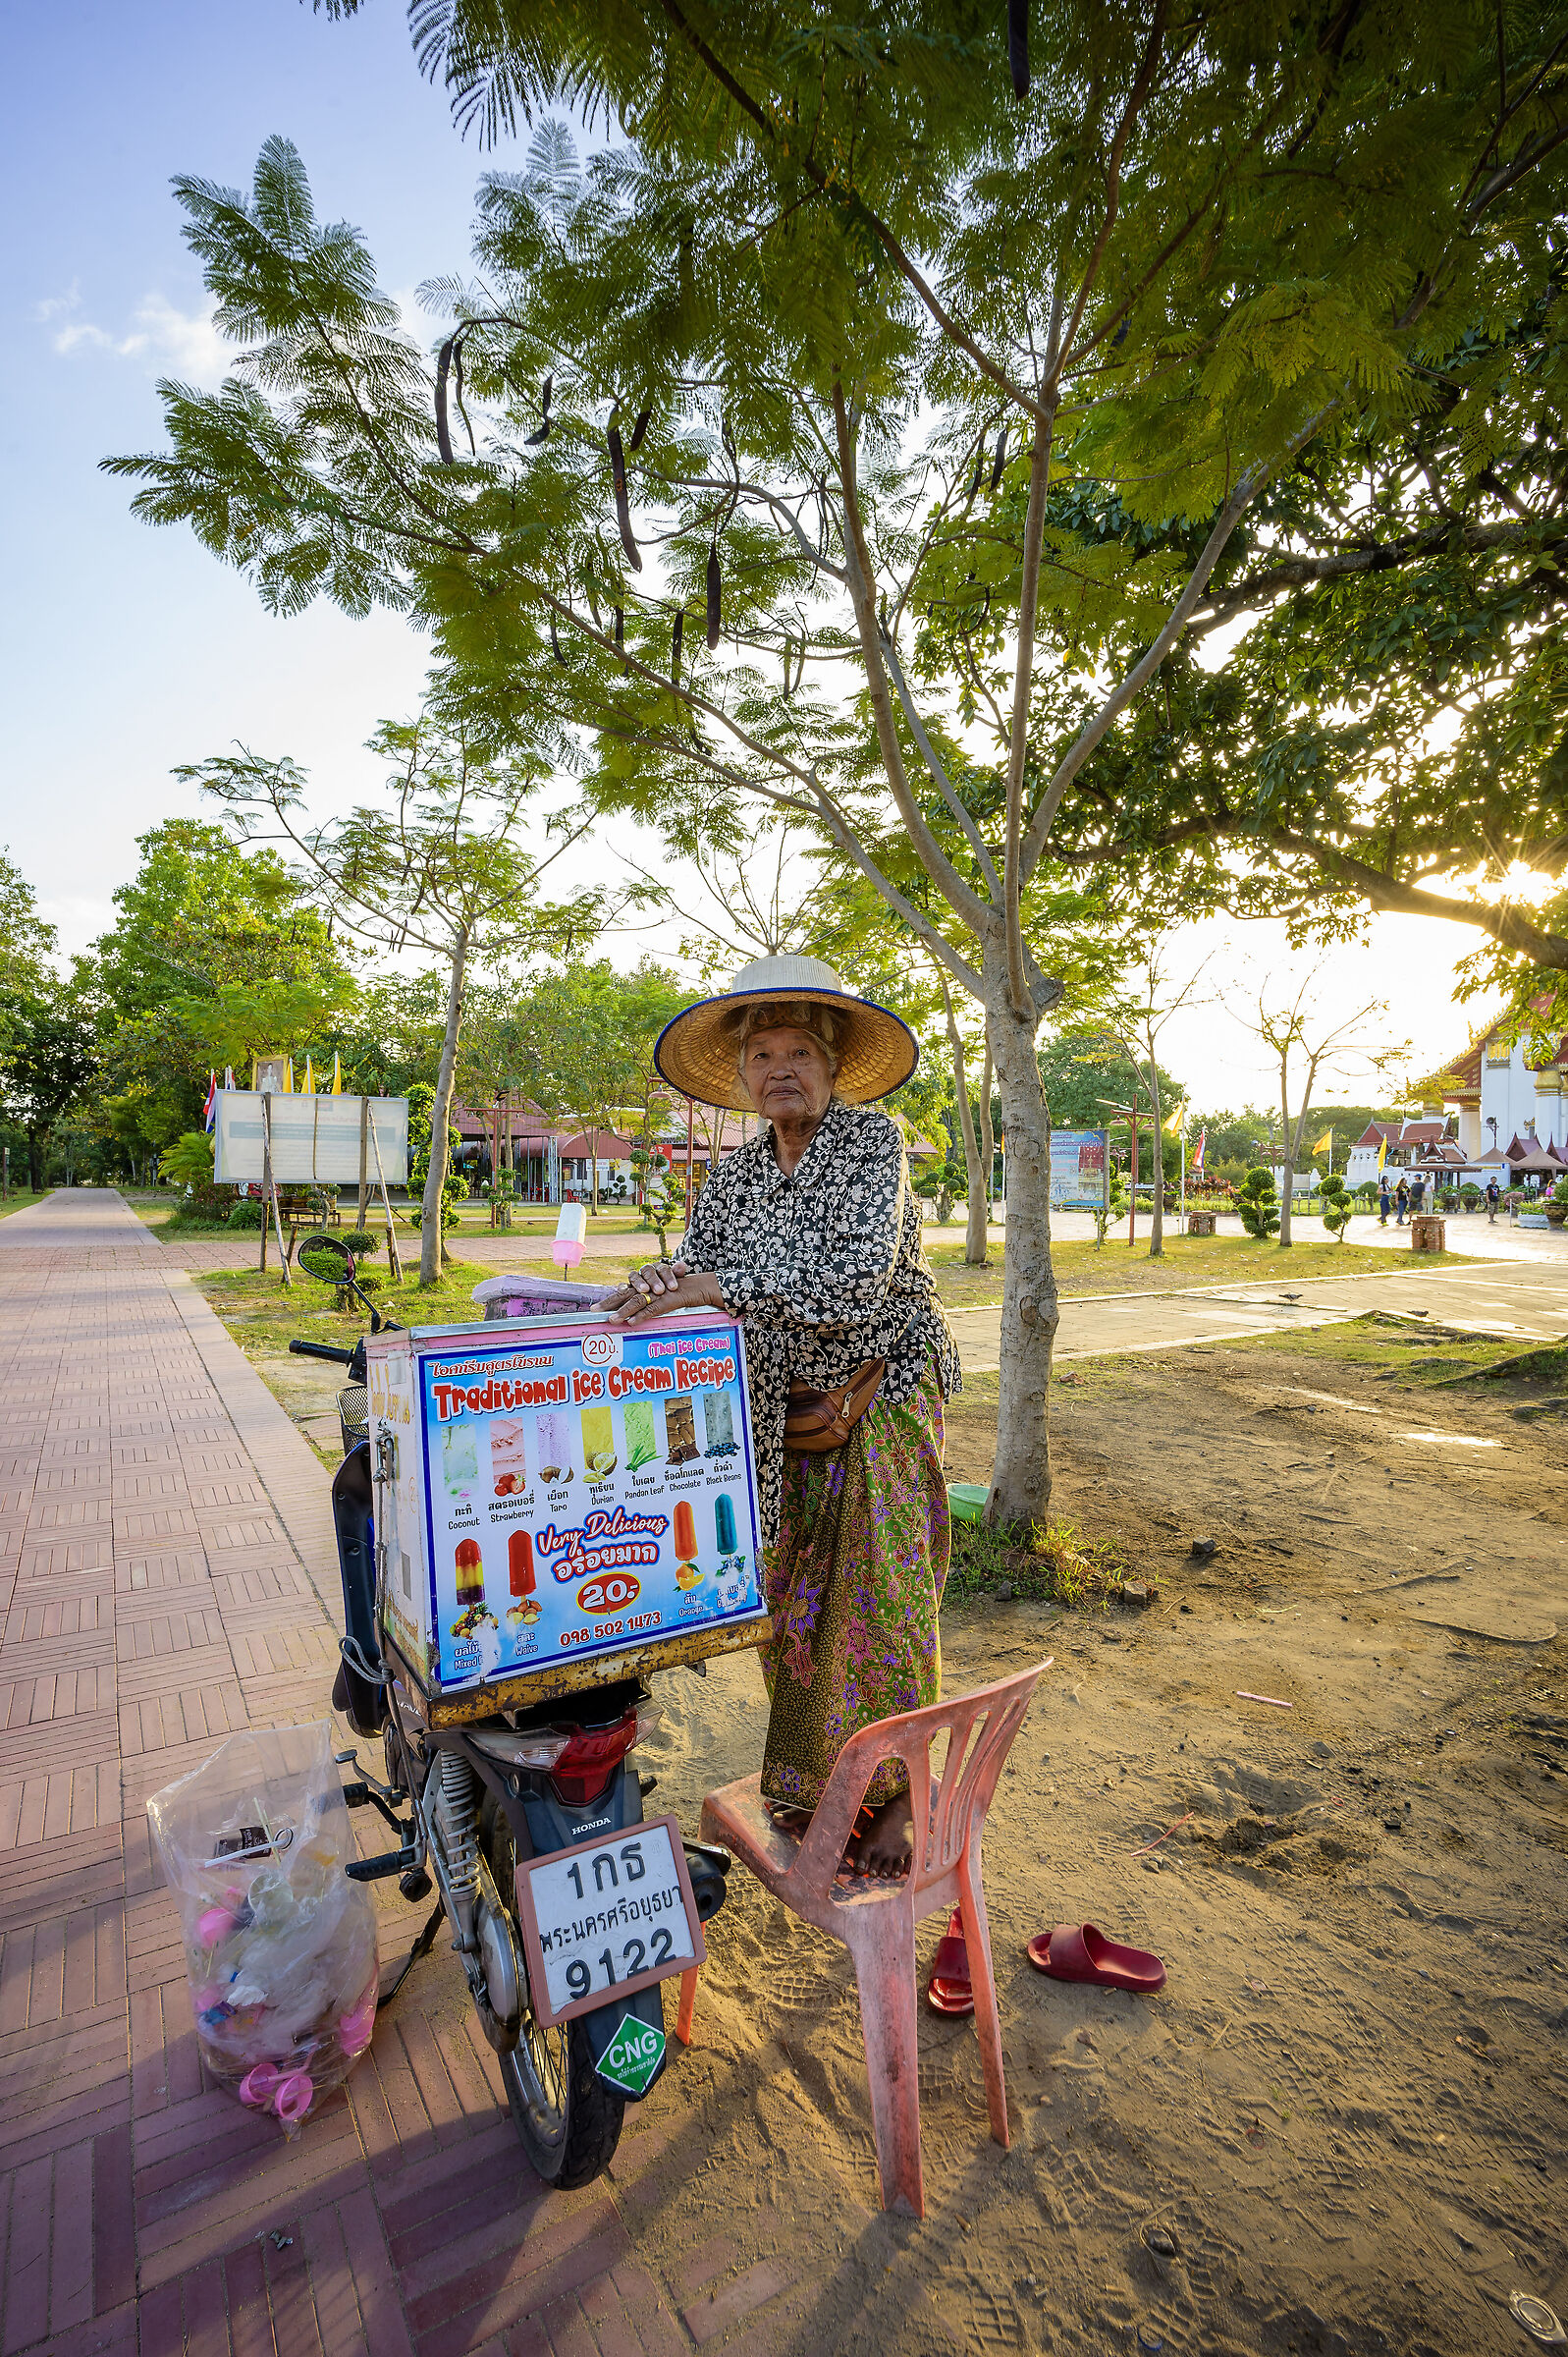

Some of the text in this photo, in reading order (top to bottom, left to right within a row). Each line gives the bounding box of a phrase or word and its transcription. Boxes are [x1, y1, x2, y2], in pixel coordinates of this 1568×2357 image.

[648, 1336, 730, 1358] (Thai ice Cream)
[428, 1354, 554, 1376] ไอศกรีมสูตรโบราณ
[432, 1375, 568, 1420] Traditional
[571, 1369, 603, 1403] ice
[607, 1365, 674, 1398] Cream
[675, 1356, 735, 1391] Recipe
[714, 1459, 733, 1473] ถั่วดำ
[631, 1475, 656, 1487] ใบเตย
[669, 1479, 701, 1492] Chocolate
[705, 1472, 742, 1486] Black Beans
[547, 1490, 569, 1502] เผือก
[589, 1481, 615, 1498] ทุเรียน
[624, 1489, 649, 1501] Pandan
[488, 1489, 536, 1511] สตรอเบอรี่
[550, 1503, 568, 1513] Taro
[591, 1495, 615, 1507] Durian
[455, 1503, 473, 1517] กะทิ
[490, 1508, 534, 1523] Strawberry
[448, 1516, 481, 1531] Coconut
[537, 1507, 668, 1559] Very Delicious
[554, 1544, 658, 1580] อร่อยมาก
[677, 1606, 704, 1618] Orange
[560, 1610, 662, 1647] 098 502 1473
[454, 1655, 477, 1671] Mixed
[571, 1817, 612, 1836] HONDA
[567, 1842, 646, 1899] 1กธ
[539, 1885, 683, 1953] พระนครศรีอยุธยา
[566, 1927, 676, 2000] 9122
[609, 2030, 658, 2068] CNG
